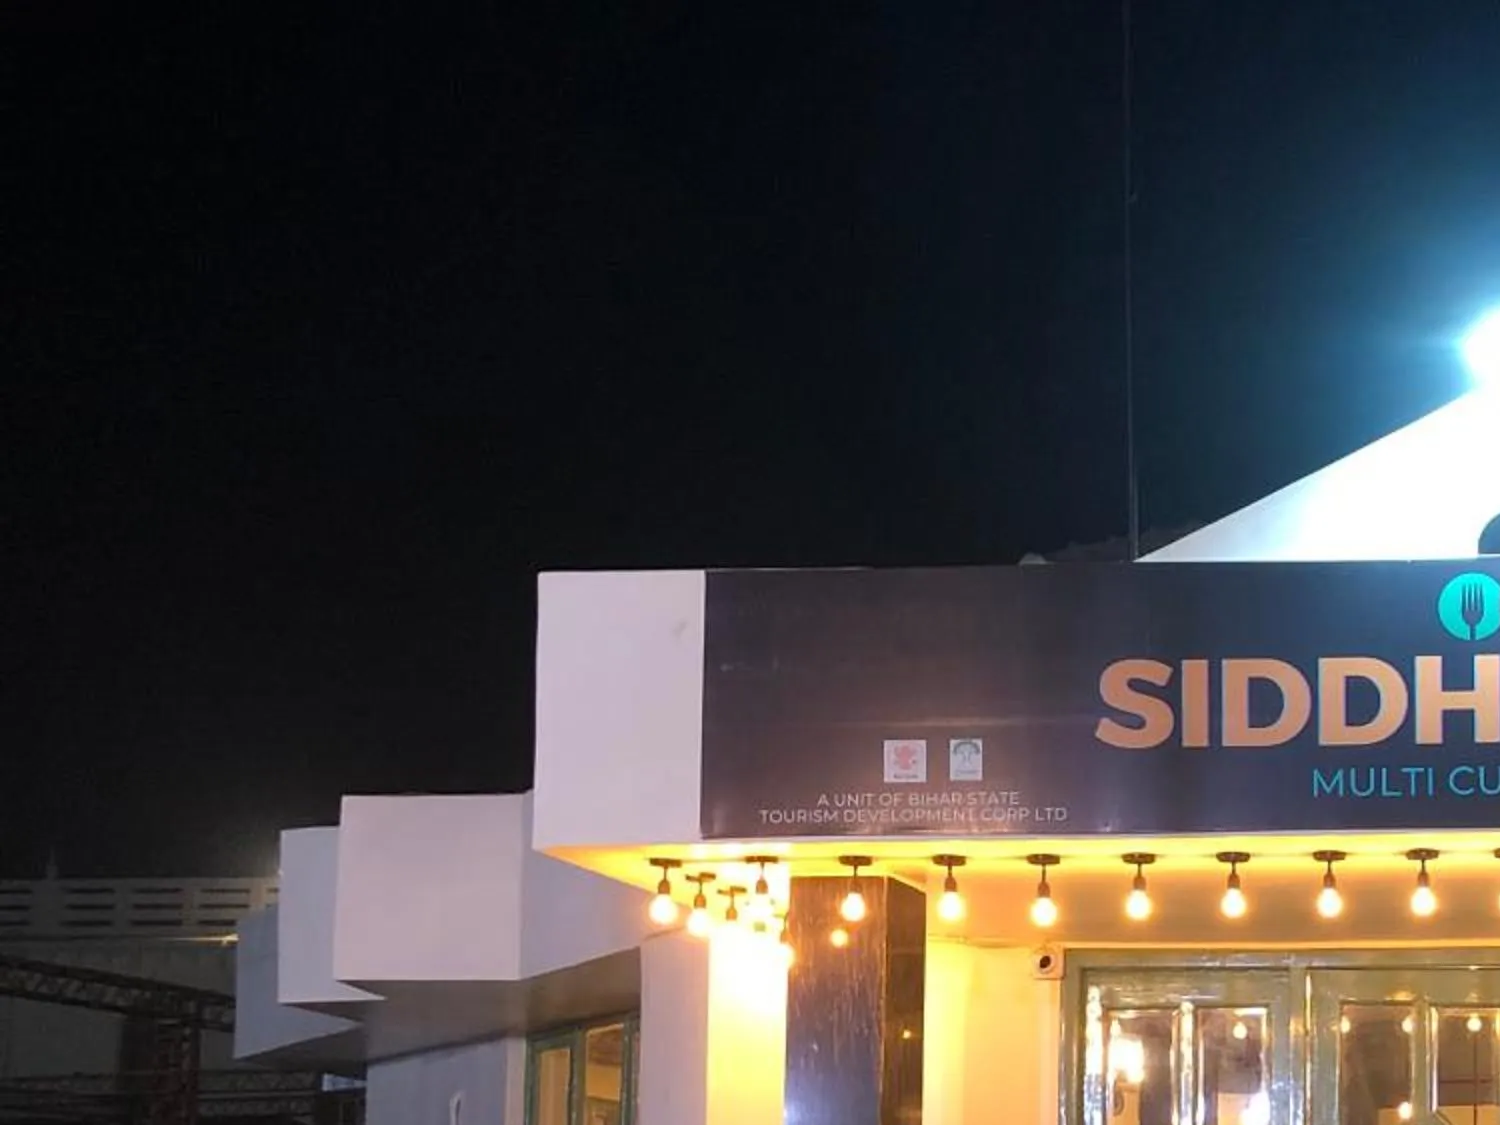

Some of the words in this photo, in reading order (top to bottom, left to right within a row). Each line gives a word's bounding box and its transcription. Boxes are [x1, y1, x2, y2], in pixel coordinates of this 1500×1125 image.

[1312, 767, 1435, 798] MULTI
[817, 793, 830, 807] A
[834, 793, 874, 807] UNIT
[879, 793, 904, 806] OF
[909, 792, 961, 806] BIHAR
[967, 791, 1020, 805] STATE
[760, 809, 838, 824] TOURISM
[843, 807, 973, 823] DEVELOPMENT
[981, 807, 1030, 821] CORP
[1035, 806, 1068, 822] LTD
